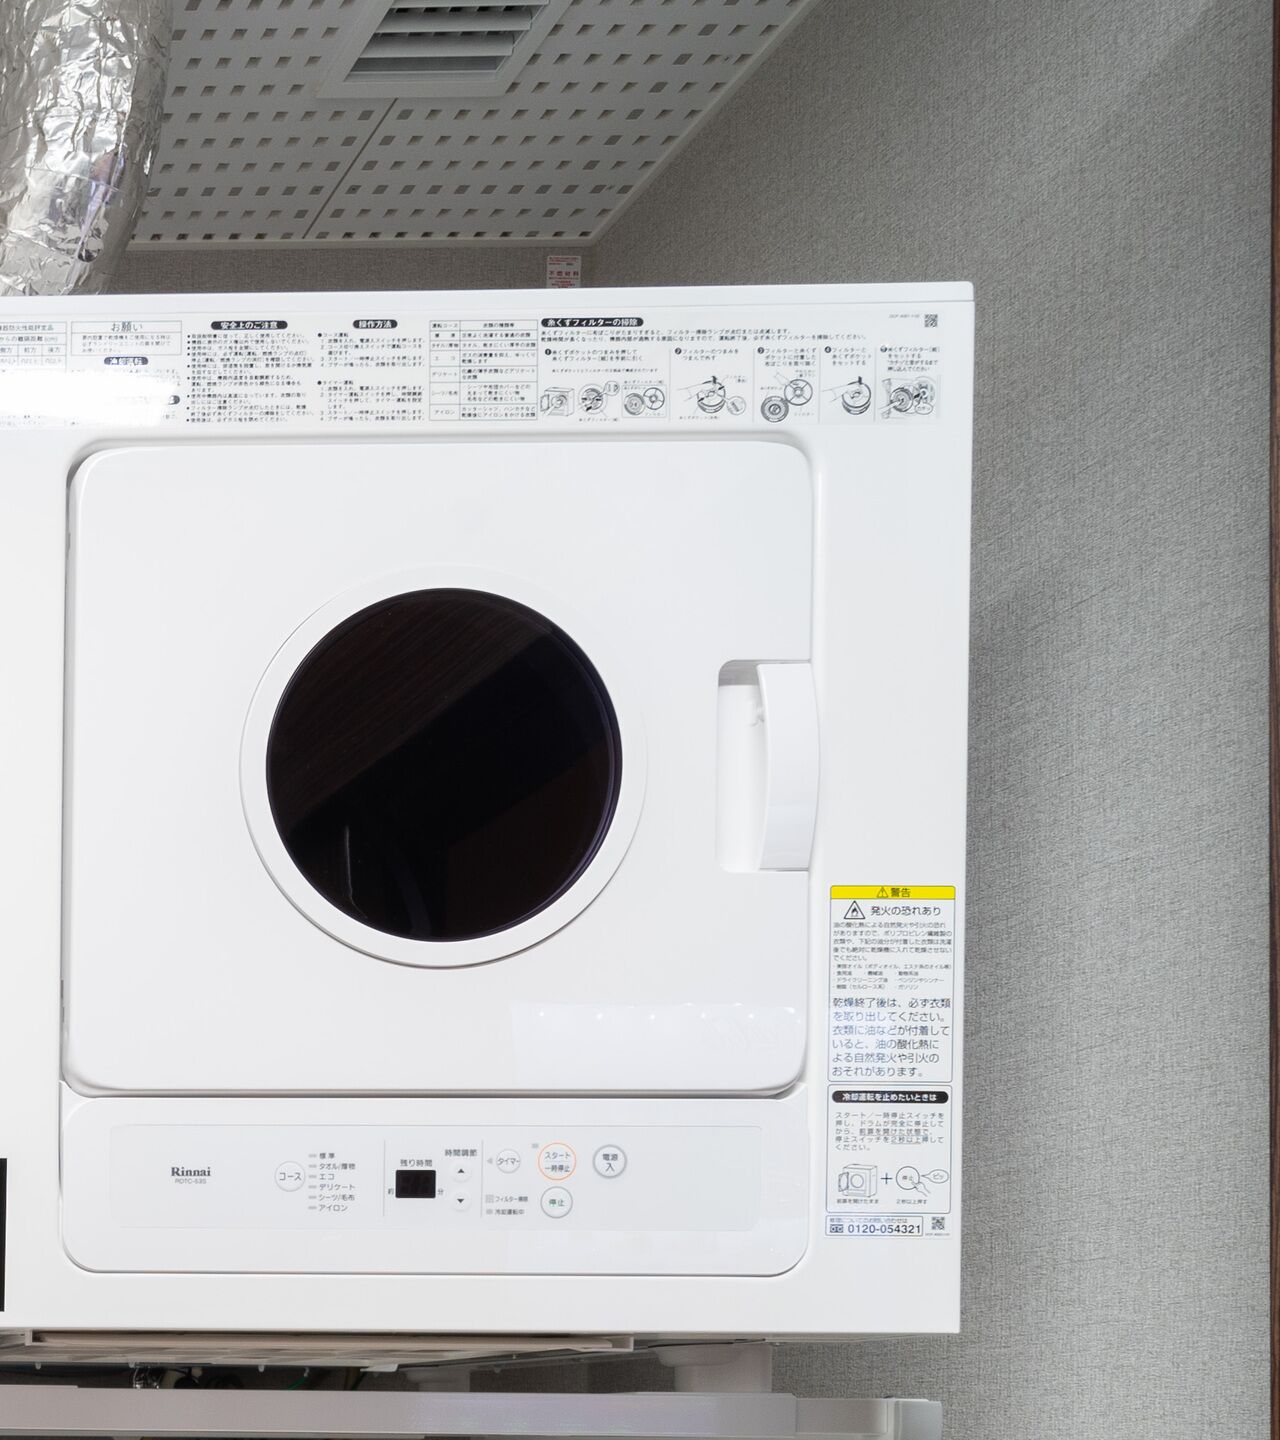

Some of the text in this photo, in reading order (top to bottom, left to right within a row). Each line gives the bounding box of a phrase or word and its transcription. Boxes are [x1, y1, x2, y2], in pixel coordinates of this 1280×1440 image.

[110, 320, 144, 334] お願い
[220, 320, 278, 330] 安全上のご注意
[359, 319, 391, 329] 操作方法
[547, 317, 638, 328] 糸くずフィルターの掃除
[889, 887, 911, 898] 警告
[870, 906, 942, 917] 発火の恐れあり
[832, 997, 952, 1009] 乾燥終了後は、必ず衣類
[833, 1010, 945, 1023] を取り出してください。
[832, 1024, 953, 1037] 衣類に油などが付着して
[832, 1038, 940, 1051] いると、油の酸化熱に
[831, 1052, 940, 1064] よる自然発火や引火の
[831, 1065, 923, 1078] おそれがあります。
[842, 1092, 937, 1101] 冷却運転を止めたいときは
[444, 1148, 478, 1158] 時間調節
[544, 1151, 572, 1160] スタート
[399, 1158, 433, 1168] 残り時間
[495, 1156, 522, 1167] タイマー
[170, 1166, 212, 1177] Rinnai
[278, 1171, 303, 1182] コース
[318, 1183, 356, 1192] デリケート
[318, 1193, 356, 1202] シーツ/毛布
[548, 1198, 566, 1208] 停止
[318, 1203, 349, 1213] アイロン
[847, 1223, 921, 1235] 0120-054321
